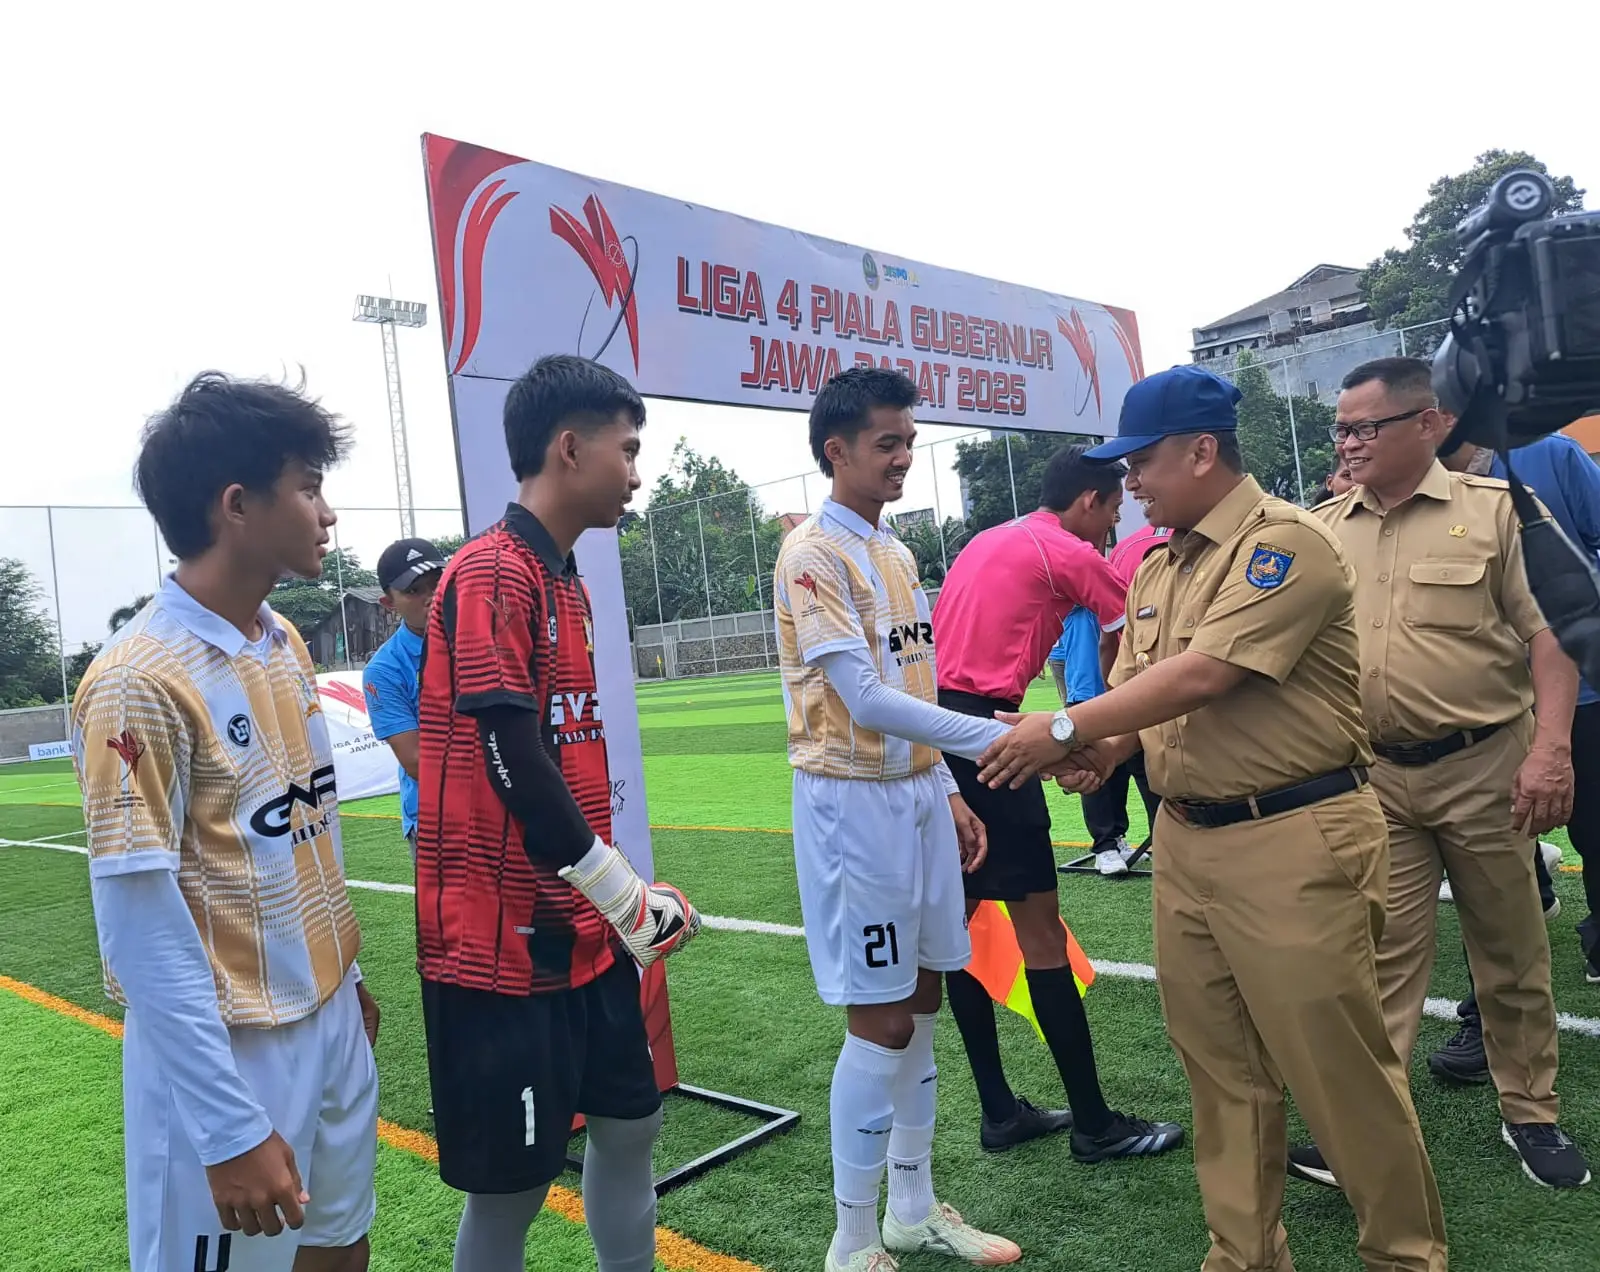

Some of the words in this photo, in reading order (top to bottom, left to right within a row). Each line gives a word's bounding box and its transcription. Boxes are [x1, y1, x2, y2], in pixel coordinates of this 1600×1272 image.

[677, 255, 768, 326] LIGA
[776, 278, 802, 331] 4
[810, 284, 904, 348] PIALA
[910, 304, 1054, 371] GUBERNUR
[740, 335, 842, 395] JAWA
[957, 366, 1027, 415] 2025
[37, 745, 66, 757] bank
[487, 731, 512, 788] explode
[863, 921, 899, 968] 21
[521, 1086, 535, 1146] 1
